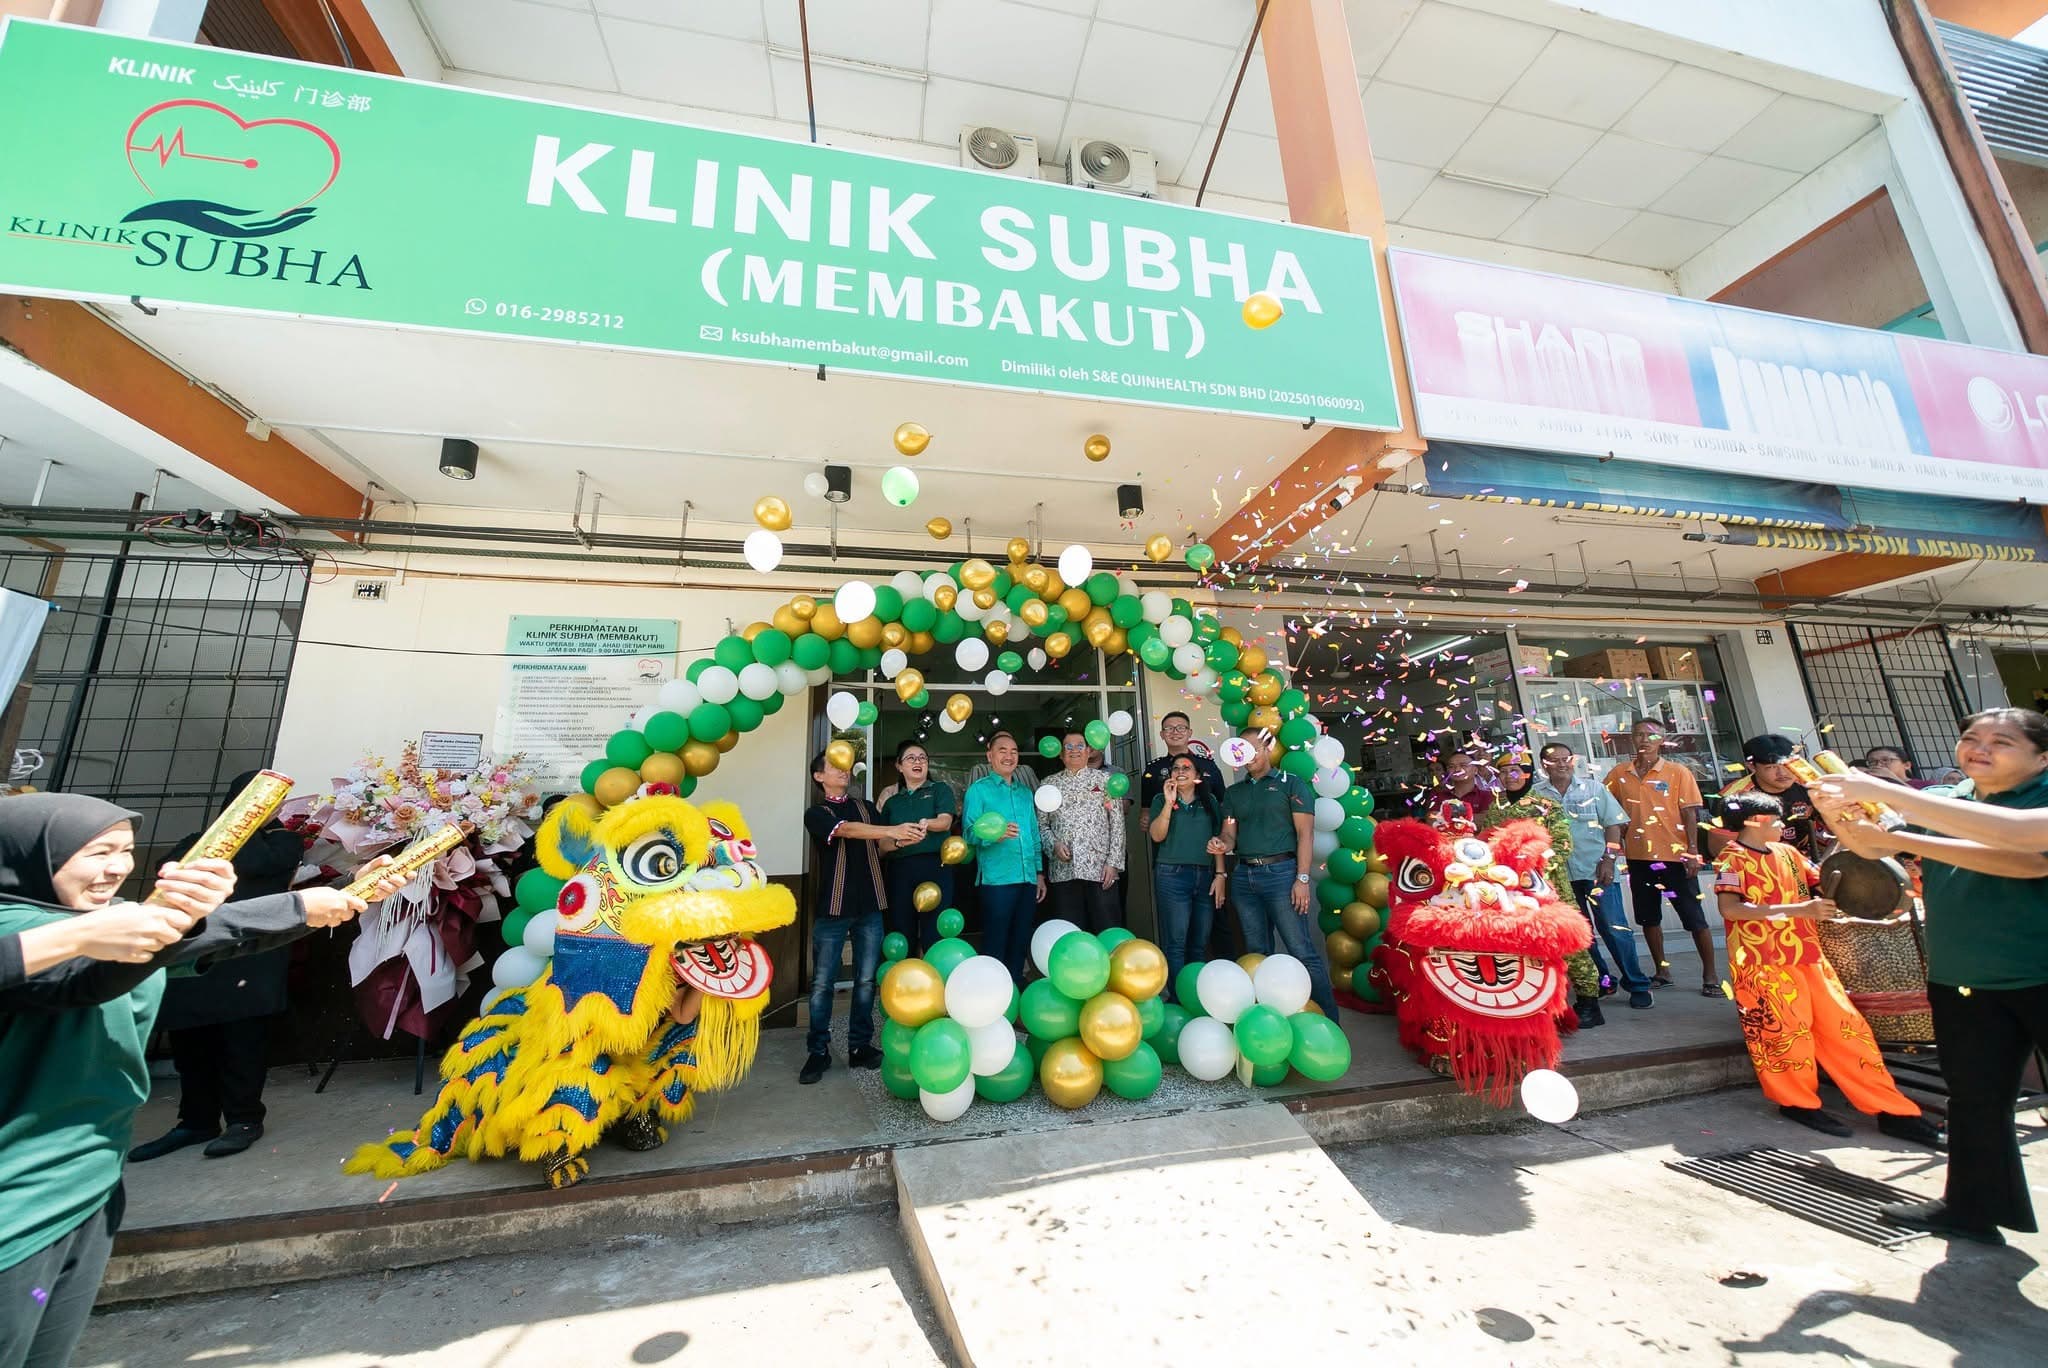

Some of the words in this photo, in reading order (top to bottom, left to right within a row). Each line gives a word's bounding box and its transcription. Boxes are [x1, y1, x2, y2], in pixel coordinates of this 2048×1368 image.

[108, 56, 197, 84] KLINIK
[294, 84, 372, 113] 门诊部
[527, 135, 937, 260] KLINIK
[980, 205, 1323, 315] SUBHA
[9, 216, 139, 245] KLINIK
[135, 230, 373, 290] SUBHA
[495, 302, 625, 329] 016-2985212
[701, 247, 1206, 360] (MEMBAKUT)
[731, 328, 969, 368] ksubhamembakut@gmail.com
[1001, 359, 1056, 378] Dimiliki
[1059, 367, 1089, 381] oleh
[1092, 369, 1119, 384] S&E
[1121, 373, 1207, 395] QUINHEALTH
[1210, 383, 1237, 398] SDN
[1240, 386, 1266, 401] BHD
[1269, 389, 1365, 413] (202501060092)
[526, 631, 558, 639] KLINIK
[560, 632, 594, 640] SUBHA
[596, 633, 658, 642] (MEMBAKUT)
[549, 623, 626, 633] PERKHIDMATAN
[628, 625, 638, 633] DI
